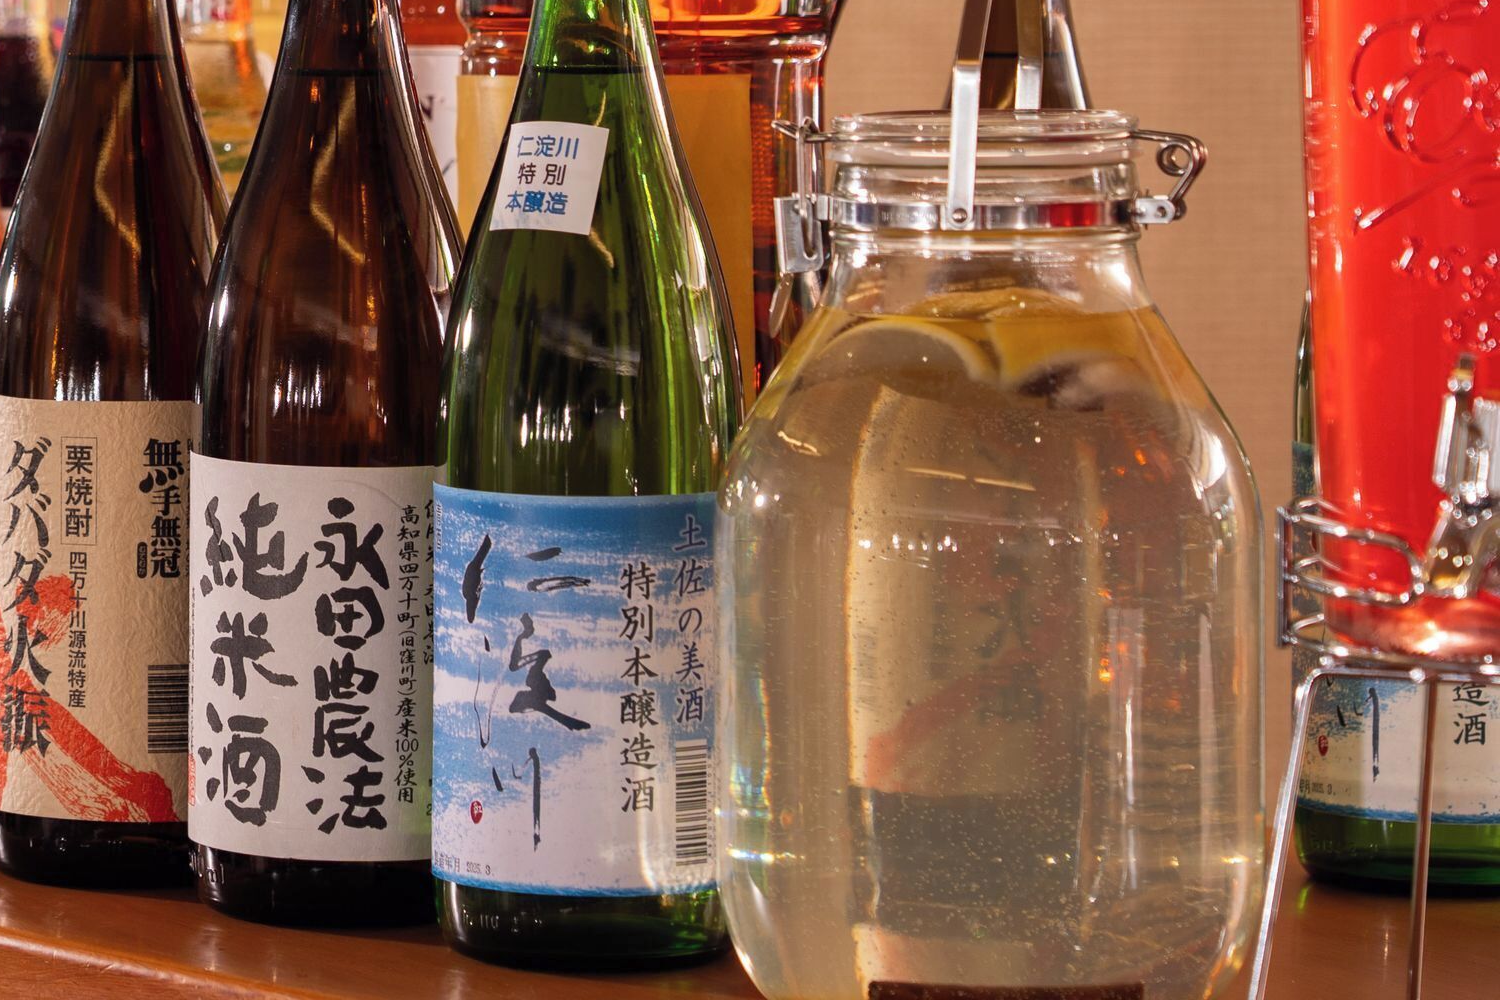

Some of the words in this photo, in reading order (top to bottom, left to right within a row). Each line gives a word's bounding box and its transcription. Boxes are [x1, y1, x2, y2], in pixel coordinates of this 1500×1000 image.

[505, 190, 568, 215] 本醸造
[517, 135, 579, 159] 仁淀川
[518, 163, 567, 186] 特別
[65, 445, 93, 538] 栗焼酎
[139, 438, 184, 578] 無手無冠
[1, 435, 53, 759] ダバダ火振
[67, 551, 88, 709] 四万十川源流特産
[198, 492, 309, 827] 純米酒
[301, 497, 390, 834] 永田農法
[674, 516, 707, 723] 土佐の美酒
[619, 562, 658, 813] 特別本醸造酒
